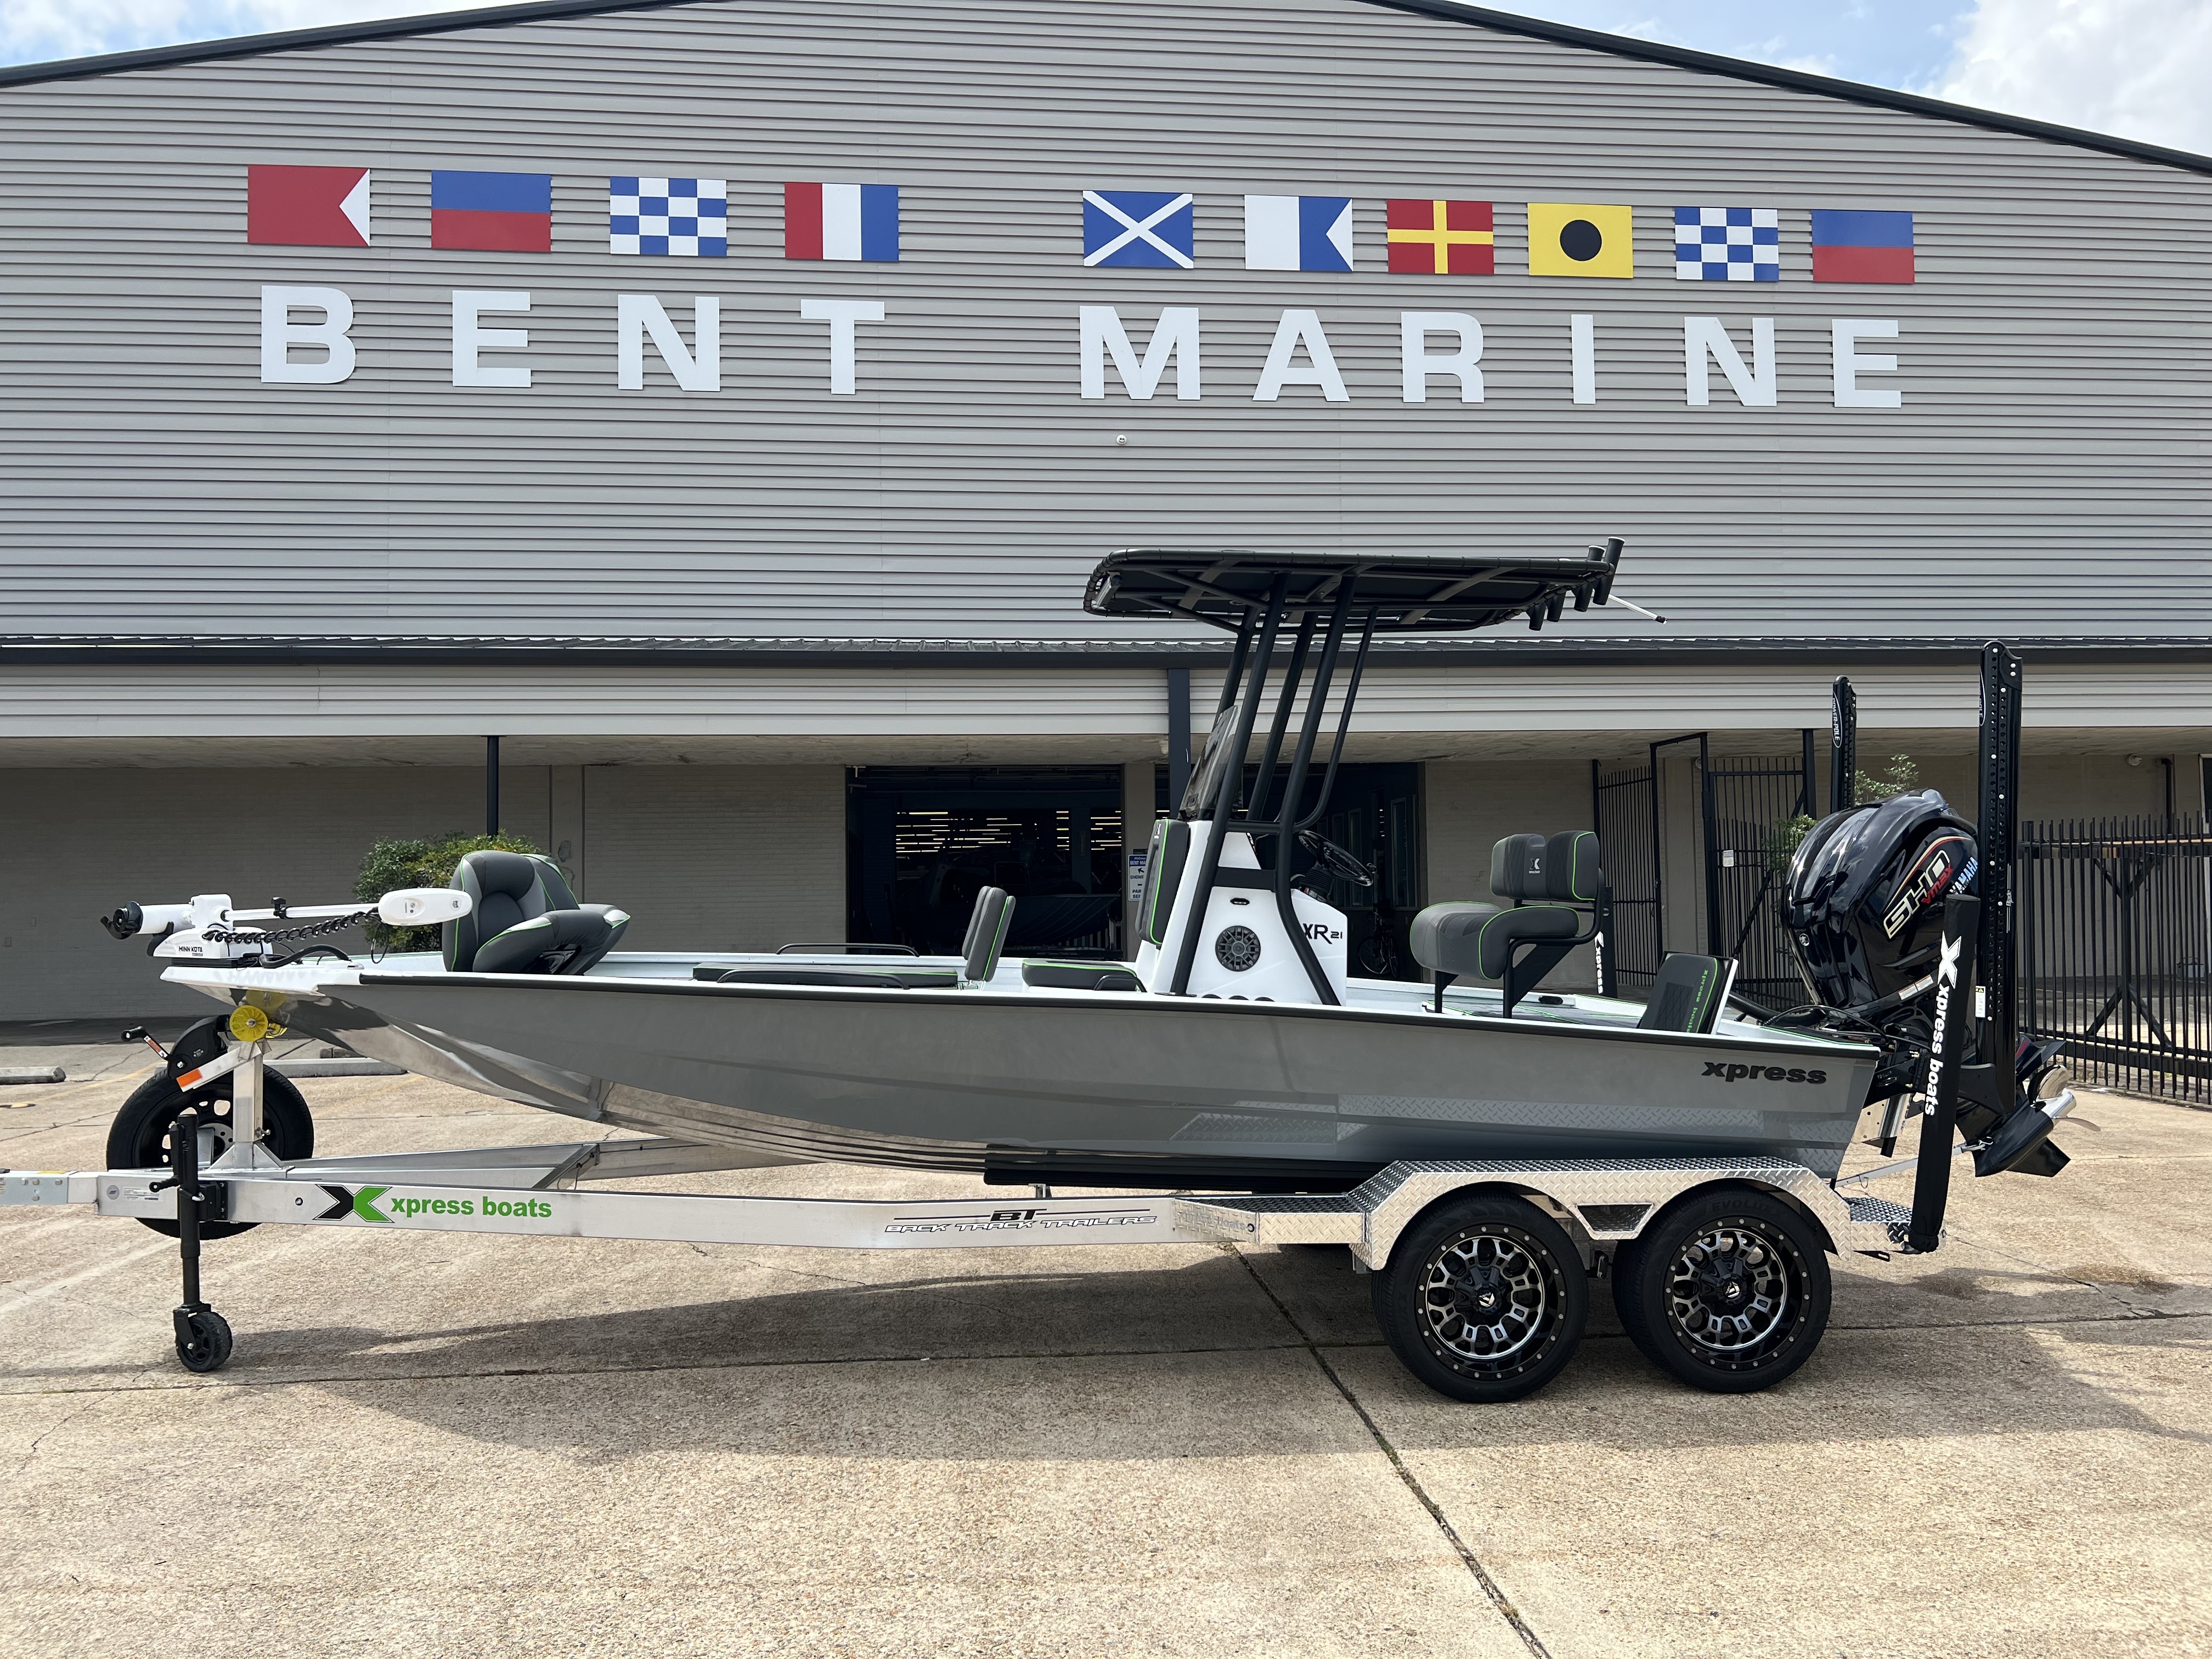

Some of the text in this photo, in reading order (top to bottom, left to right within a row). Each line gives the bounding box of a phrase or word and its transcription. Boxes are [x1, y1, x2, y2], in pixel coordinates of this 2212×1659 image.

[261, 285, 1902, 409] BENT MARINE
[1883, 850, 1951, 939] SHO
[1949, 856, 1978, 895] YAMAHA
[1302, 923, 1333, 944] XR
[1932, 983, 1950, 1055] xpress
[1701, 1062, 1827, 1085] xpress
[1925, 1058, 1943, 1116] boats
[391, 1198, 474, 1218] xpress
[482, 1196, 552, 1218] boats
[884, 1216, 1158, 1233] BACK TRACK TRAILERS
